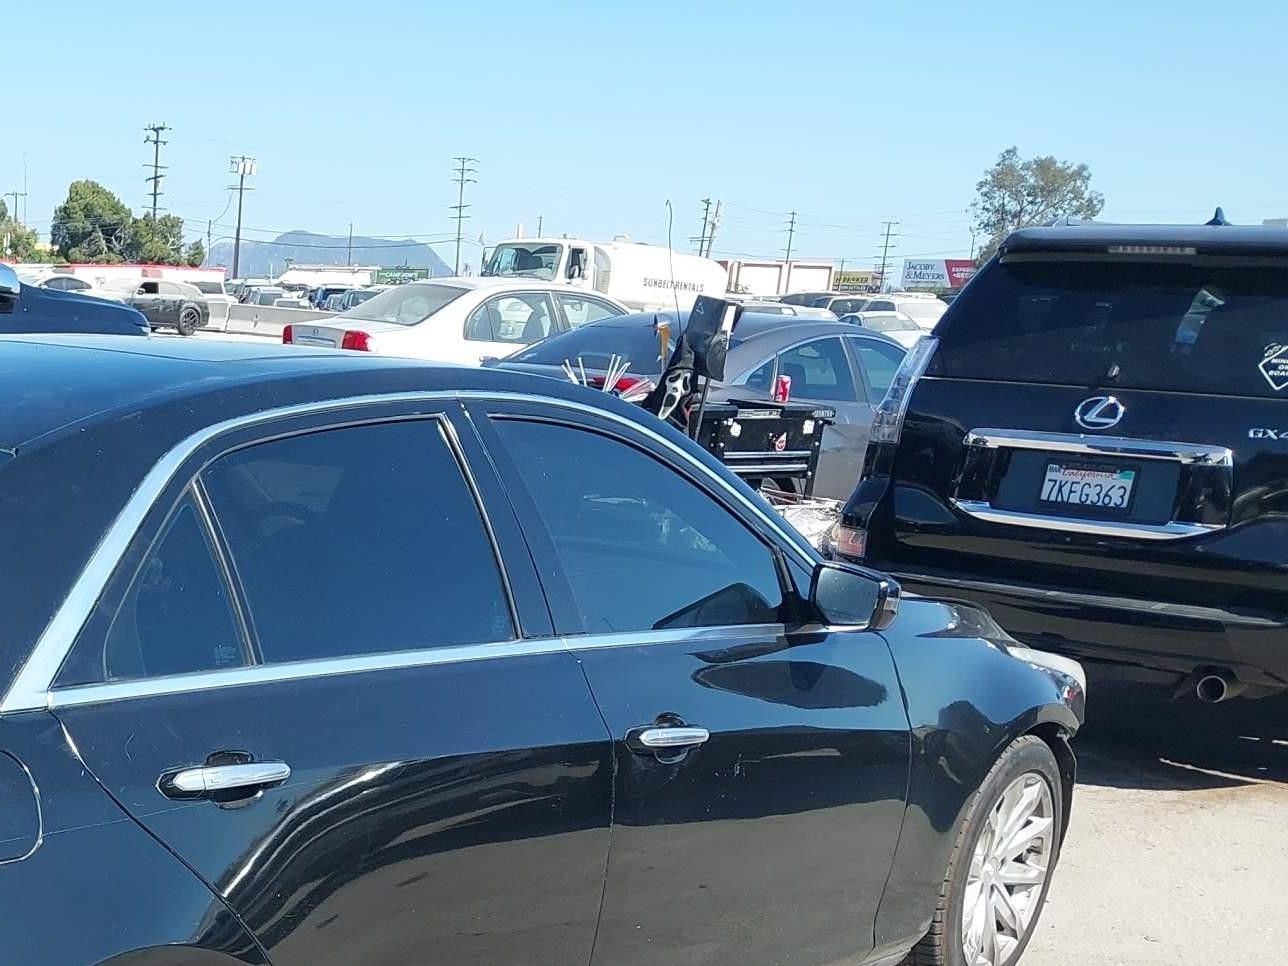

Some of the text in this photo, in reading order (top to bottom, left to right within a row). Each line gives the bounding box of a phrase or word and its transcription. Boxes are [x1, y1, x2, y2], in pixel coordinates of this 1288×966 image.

[907, 262, 935, 271] JACOBY
[912, 271, 945, 280] MEYERS
[1046, 479, 1127, 507] 7KFG363
